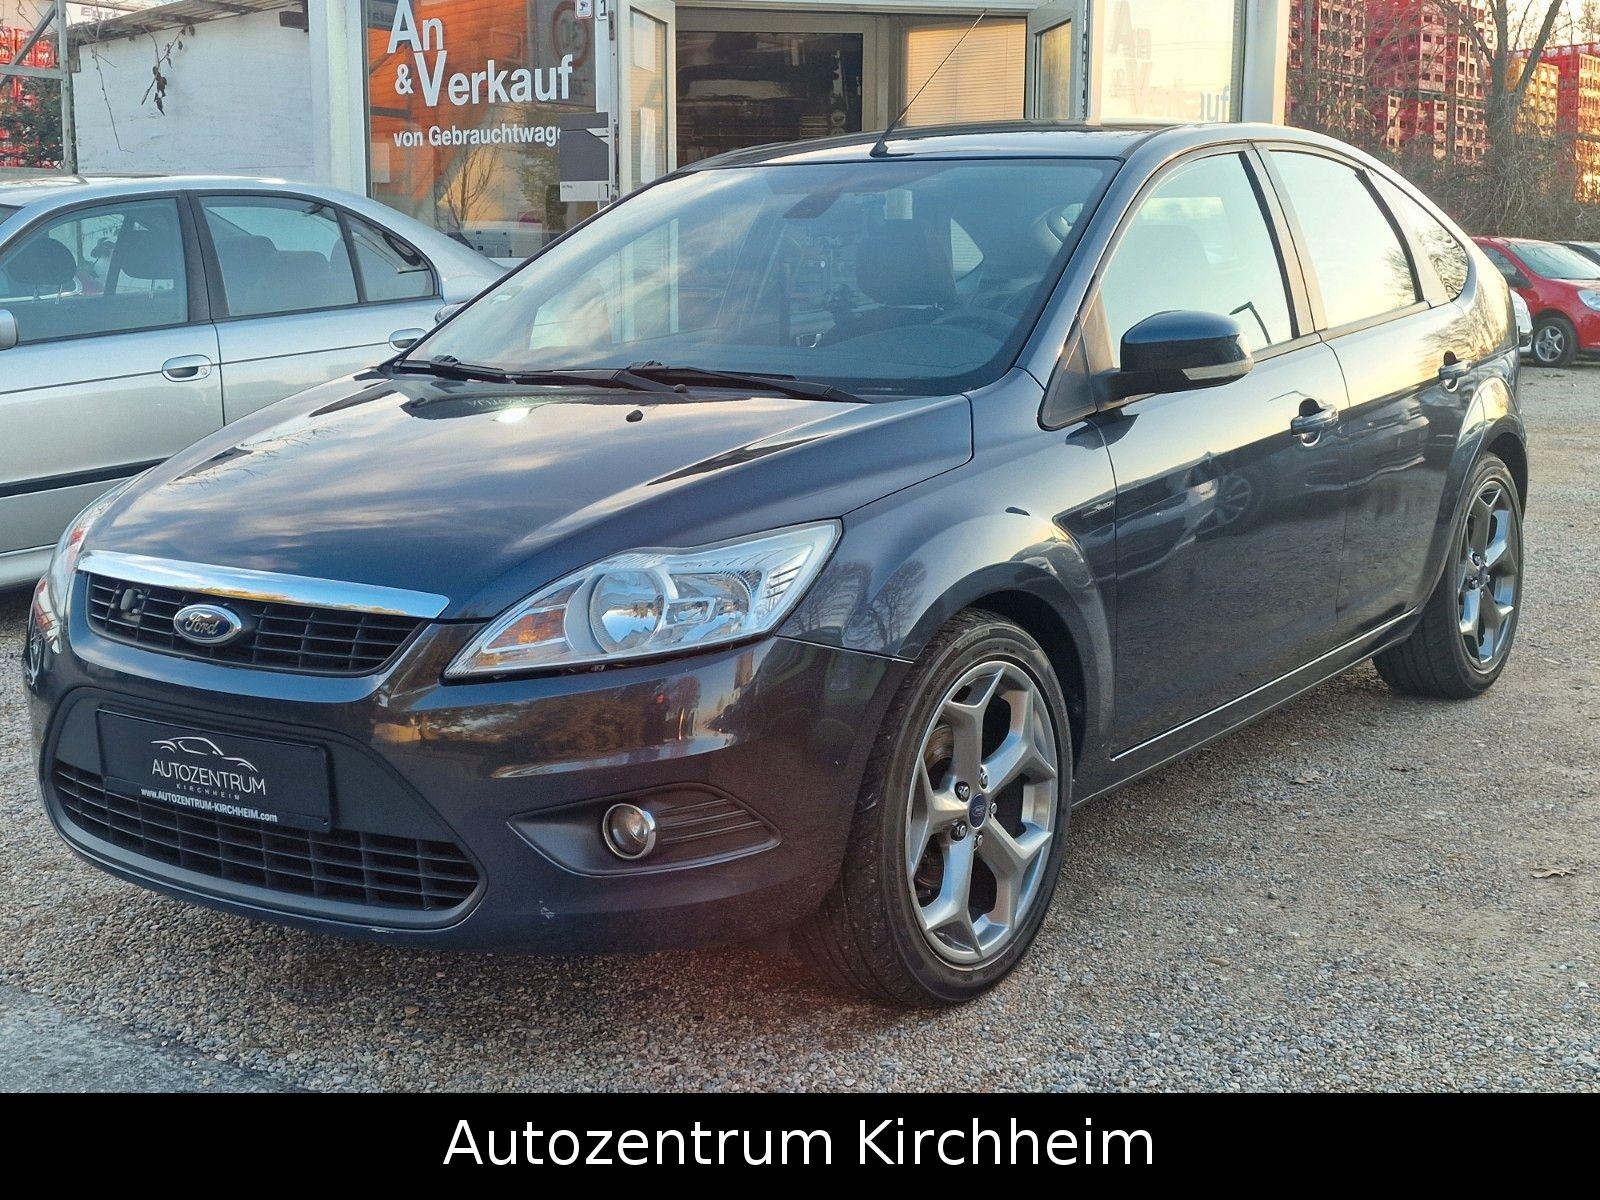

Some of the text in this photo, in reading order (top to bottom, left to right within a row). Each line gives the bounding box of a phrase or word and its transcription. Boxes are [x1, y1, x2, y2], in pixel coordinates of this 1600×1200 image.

[387, 0, 444, 53] An
[394, 50, 573, 107] & Verkauf
[393, 130, 423, 147] von
[184, 611, 220, 635] Ford
[152, 759, 266, 795] AUTOZENTRUM
[176, 783, 240, 801] KIRCHHEIM
[141, 788, 278, 823] www.AUTOZENTRUM-KIRCHHEIM.com
